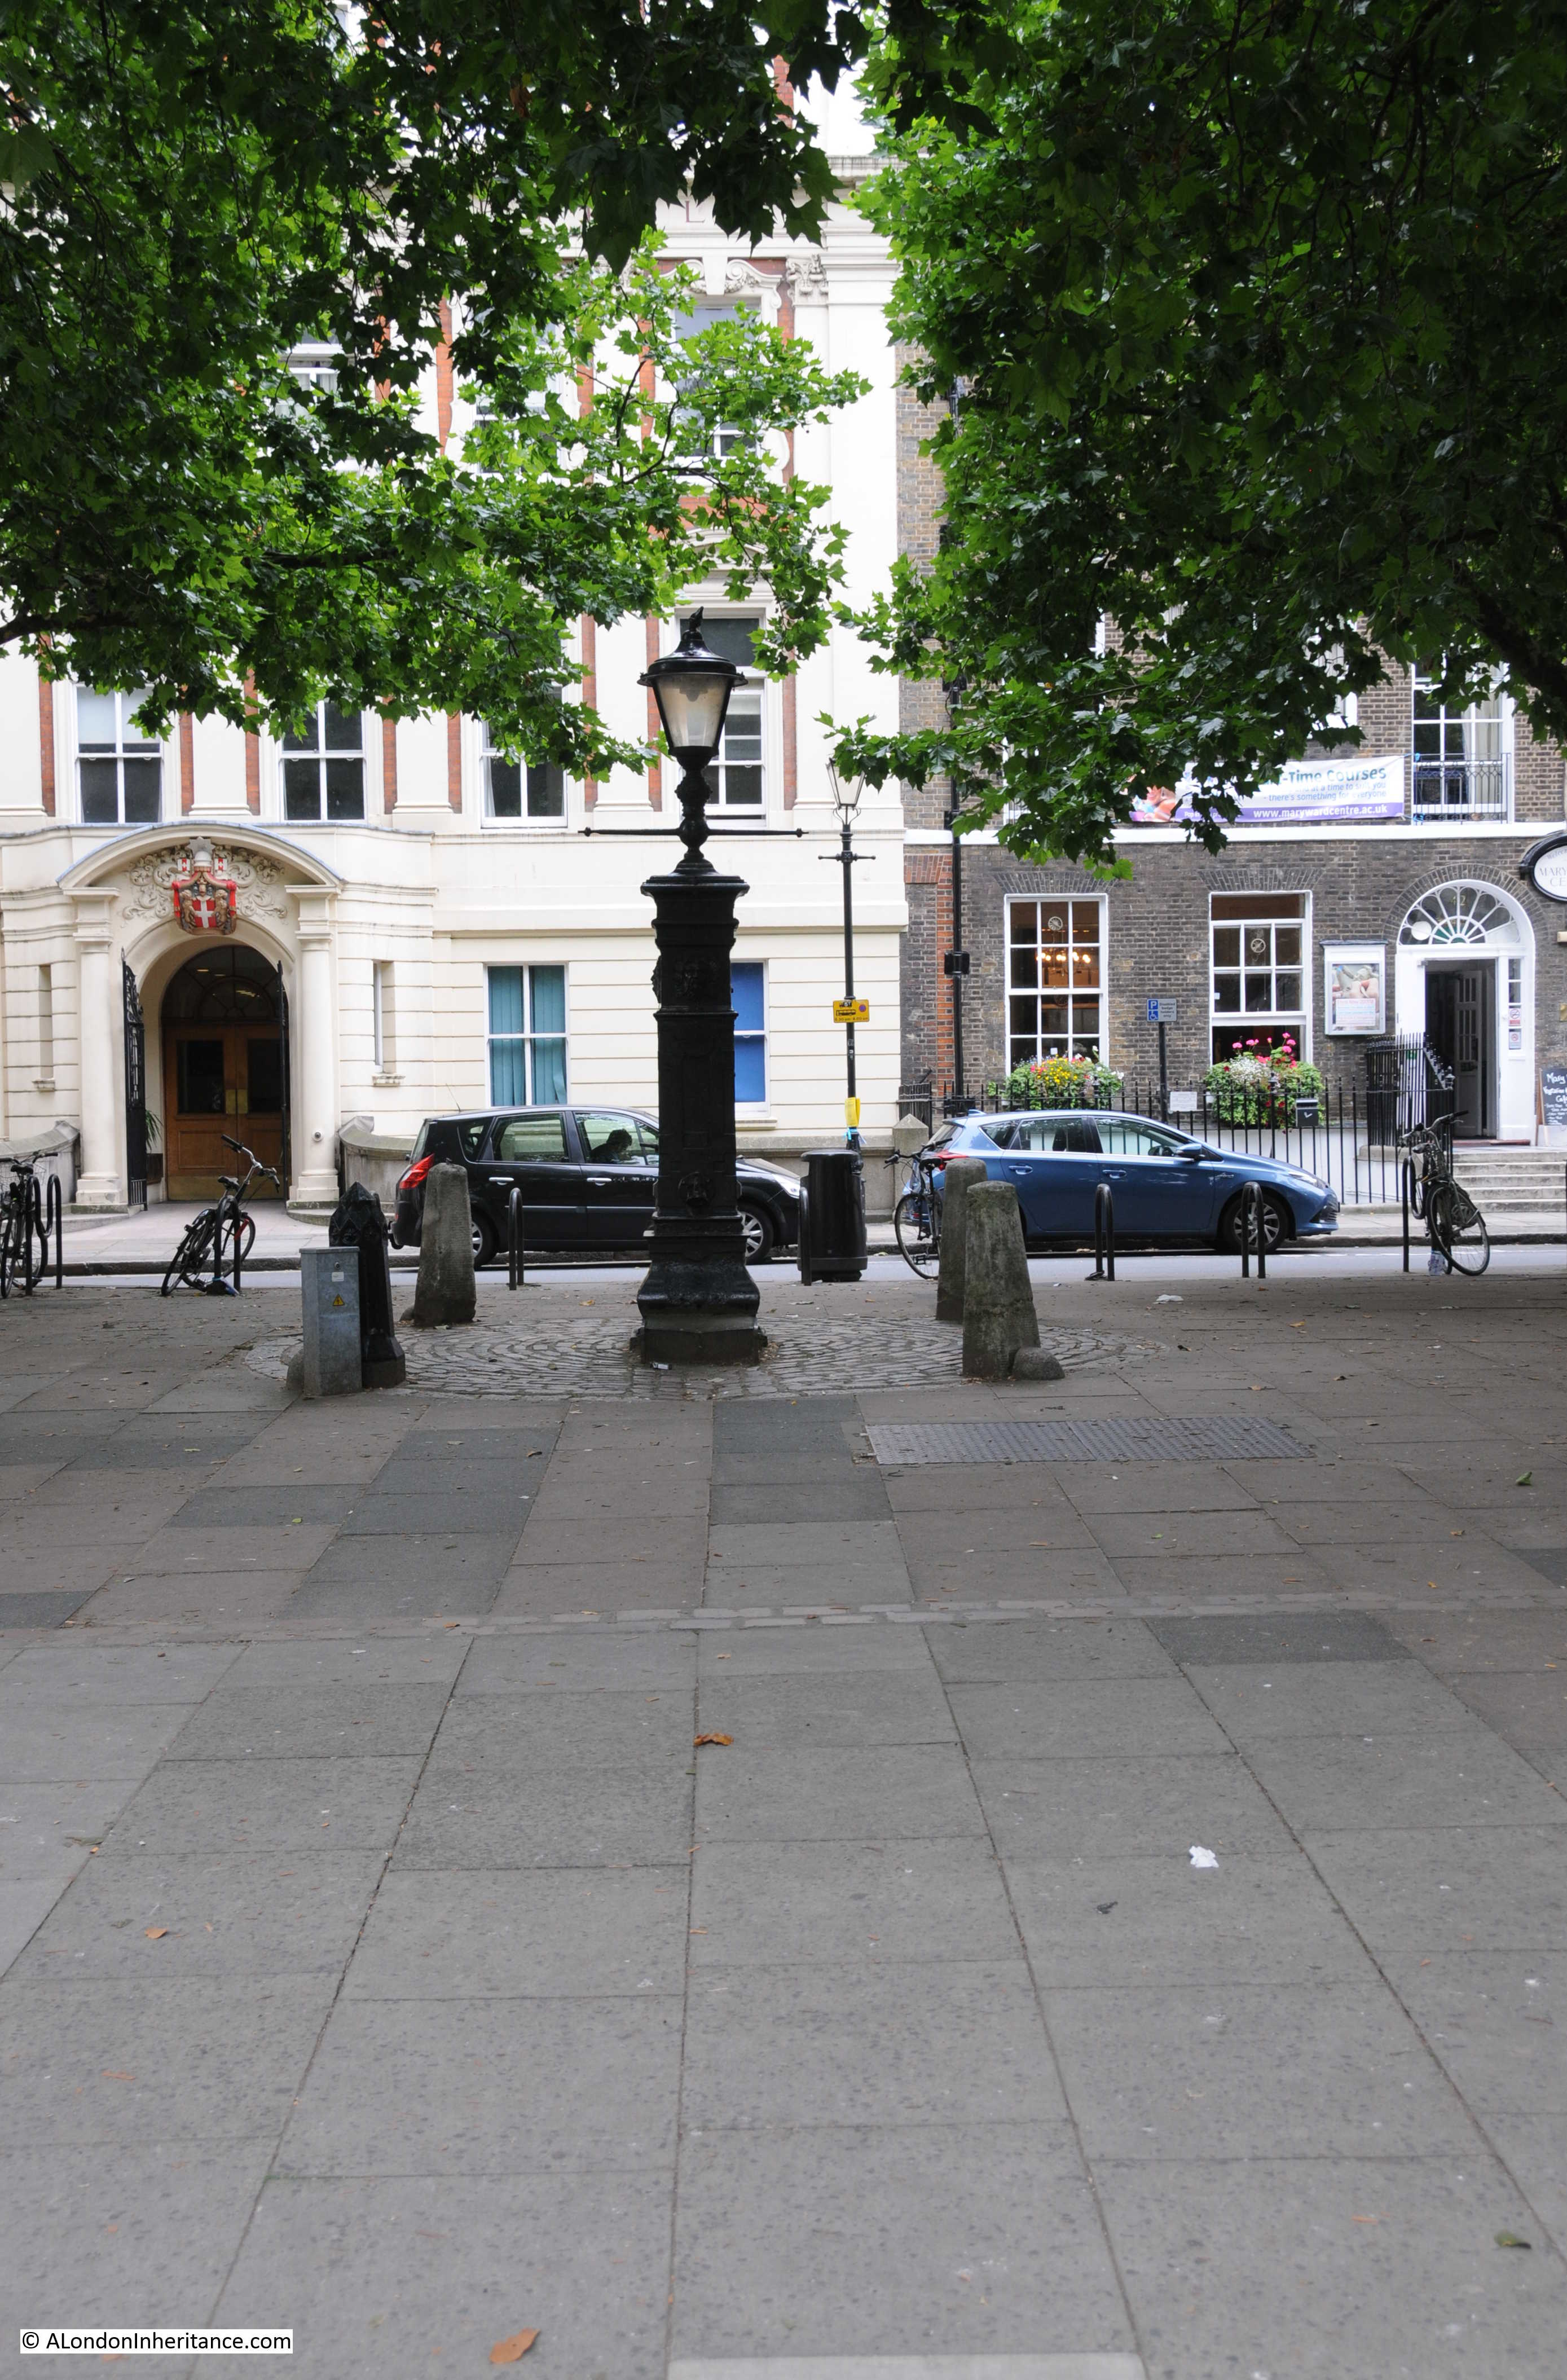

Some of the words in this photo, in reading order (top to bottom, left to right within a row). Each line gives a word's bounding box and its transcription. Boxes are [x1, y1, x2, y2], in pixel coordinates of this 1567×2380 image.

[1264, 769, 1322, 784] -Time
[1327, 767, 1386, 782] Courses
[1372, 781, 1386, 790] you
[1297, 791, 1336, 802] something
[1253, 804, 1388, 819] www.marywardcentre.ac.uk
[1540, 867, 1566, 876] MARY
[1151, 1001, 1157, 1009] P
[1547, 1072, 1566, 1084] Mary
